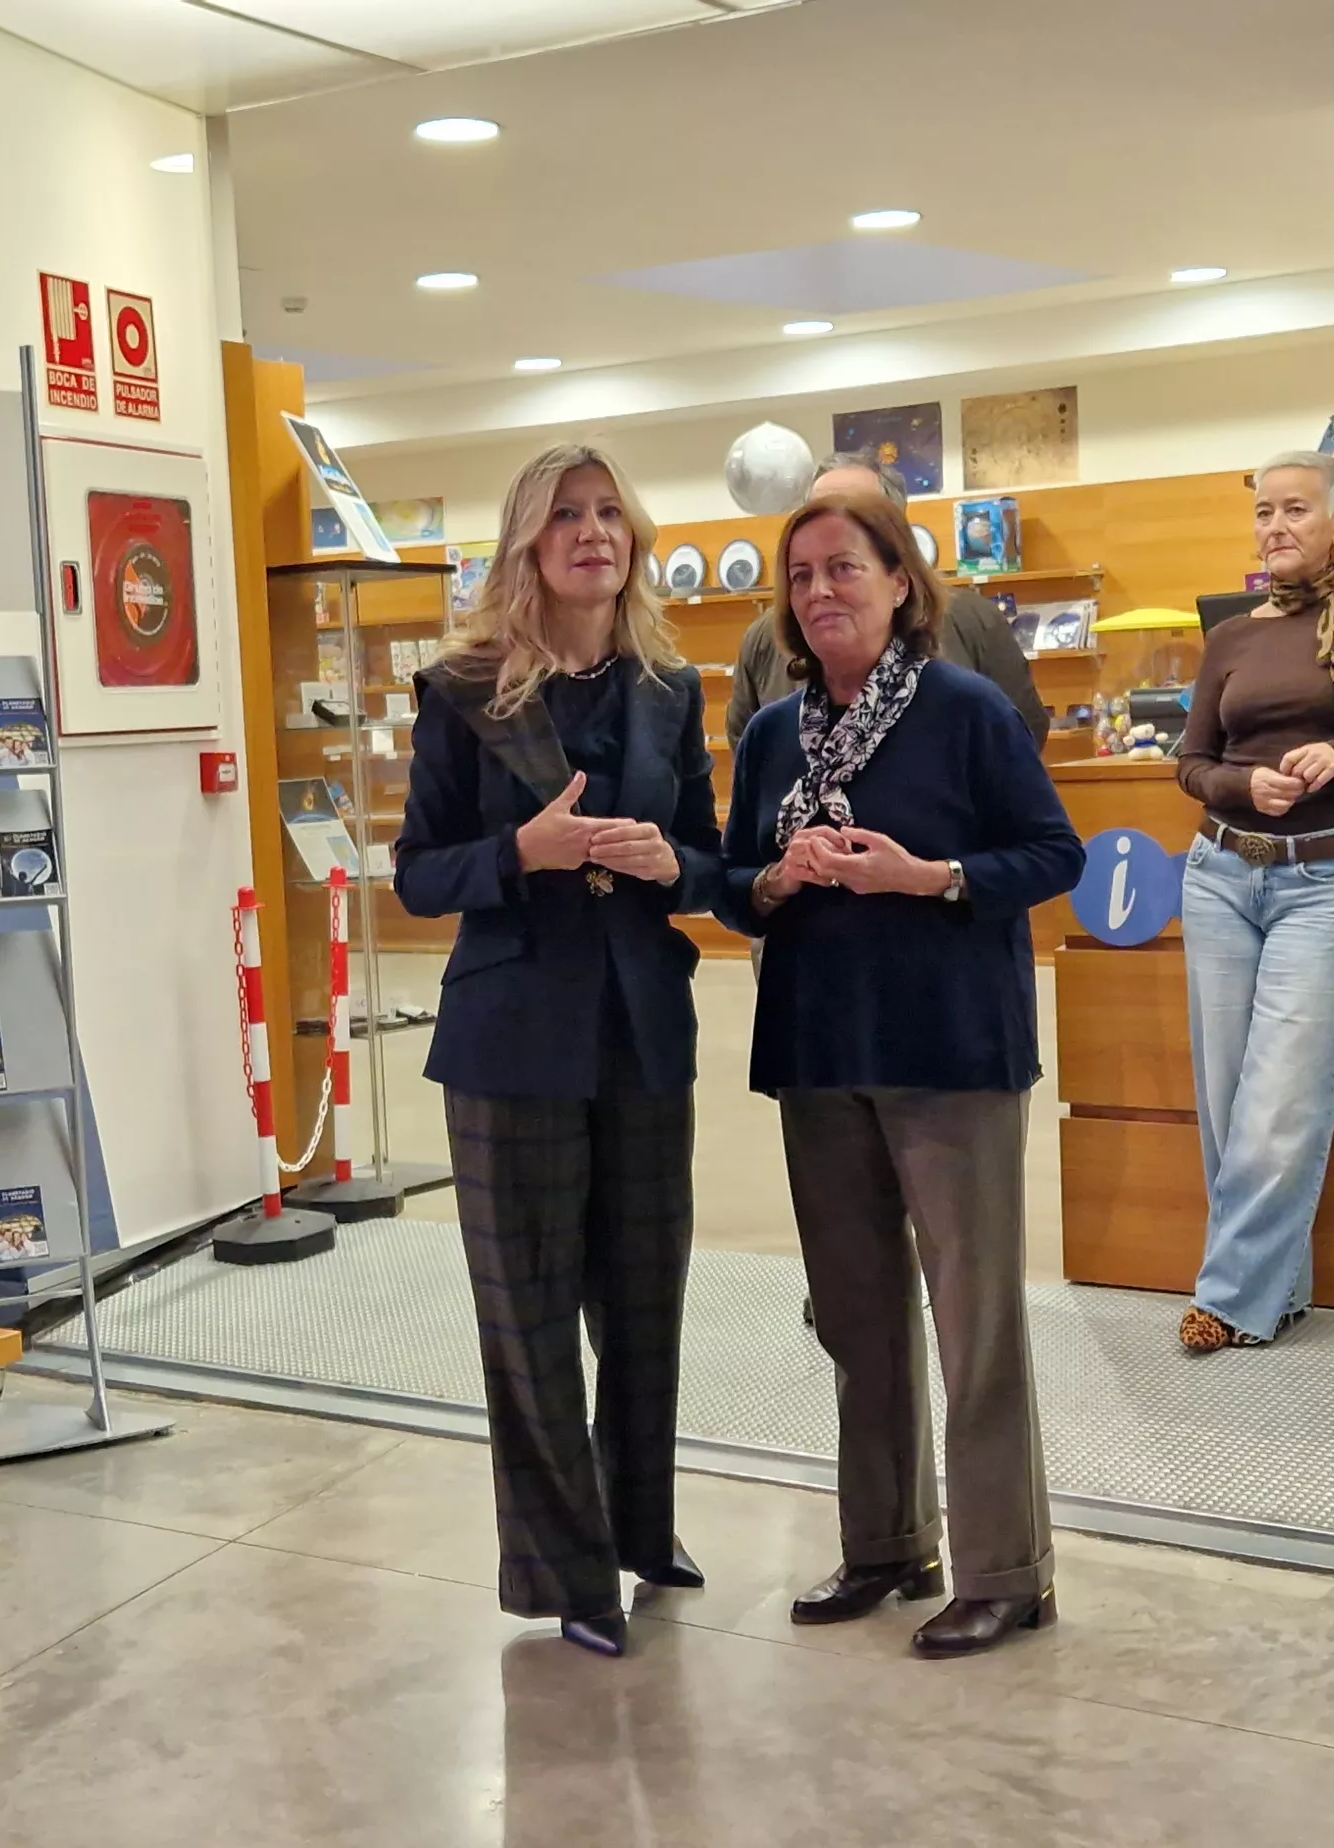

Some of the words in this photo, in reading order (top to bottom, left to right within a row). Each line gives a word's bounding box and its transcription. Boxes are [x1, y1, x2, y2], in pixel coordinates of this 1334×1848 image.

[49, 371, 77, 388] BOCA
[82, 376, 95, 391] DE
[50, 388, 97, 409] INCENDIO
[116, 383, 157, 402] PULSADOR
[116, 401, 127, 413] DE
[128, 402, 158, 417] ALARMA
